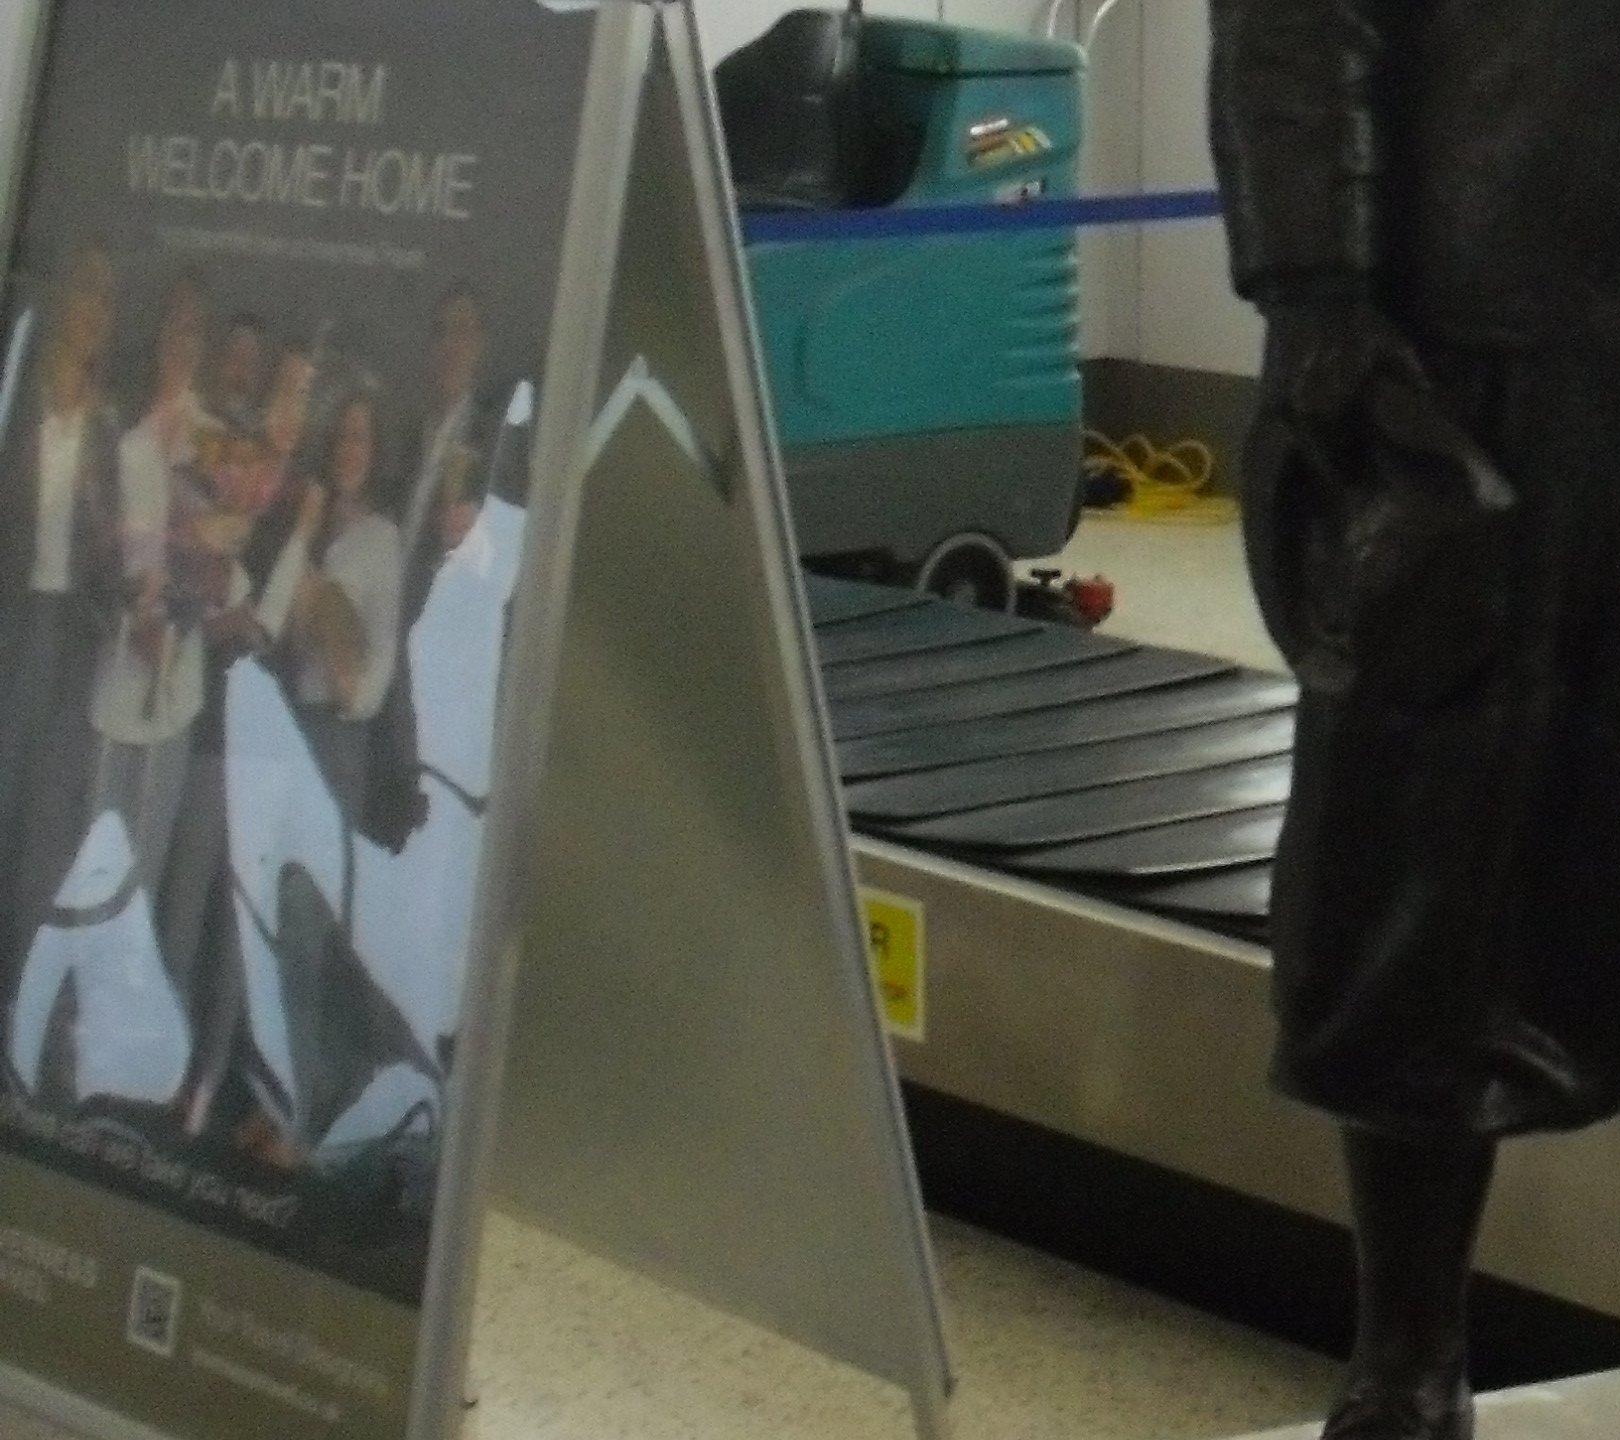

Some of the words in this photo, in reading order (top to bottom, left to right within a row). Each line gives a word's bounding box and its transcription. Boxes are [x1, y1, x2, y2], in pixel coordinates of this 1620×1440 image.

[211, 60, 239, 118] A
[252, 60, 387, 123] WARM
[127, 133, 334, 209] WELCOME
[340, 148, 477, 221] HOME
